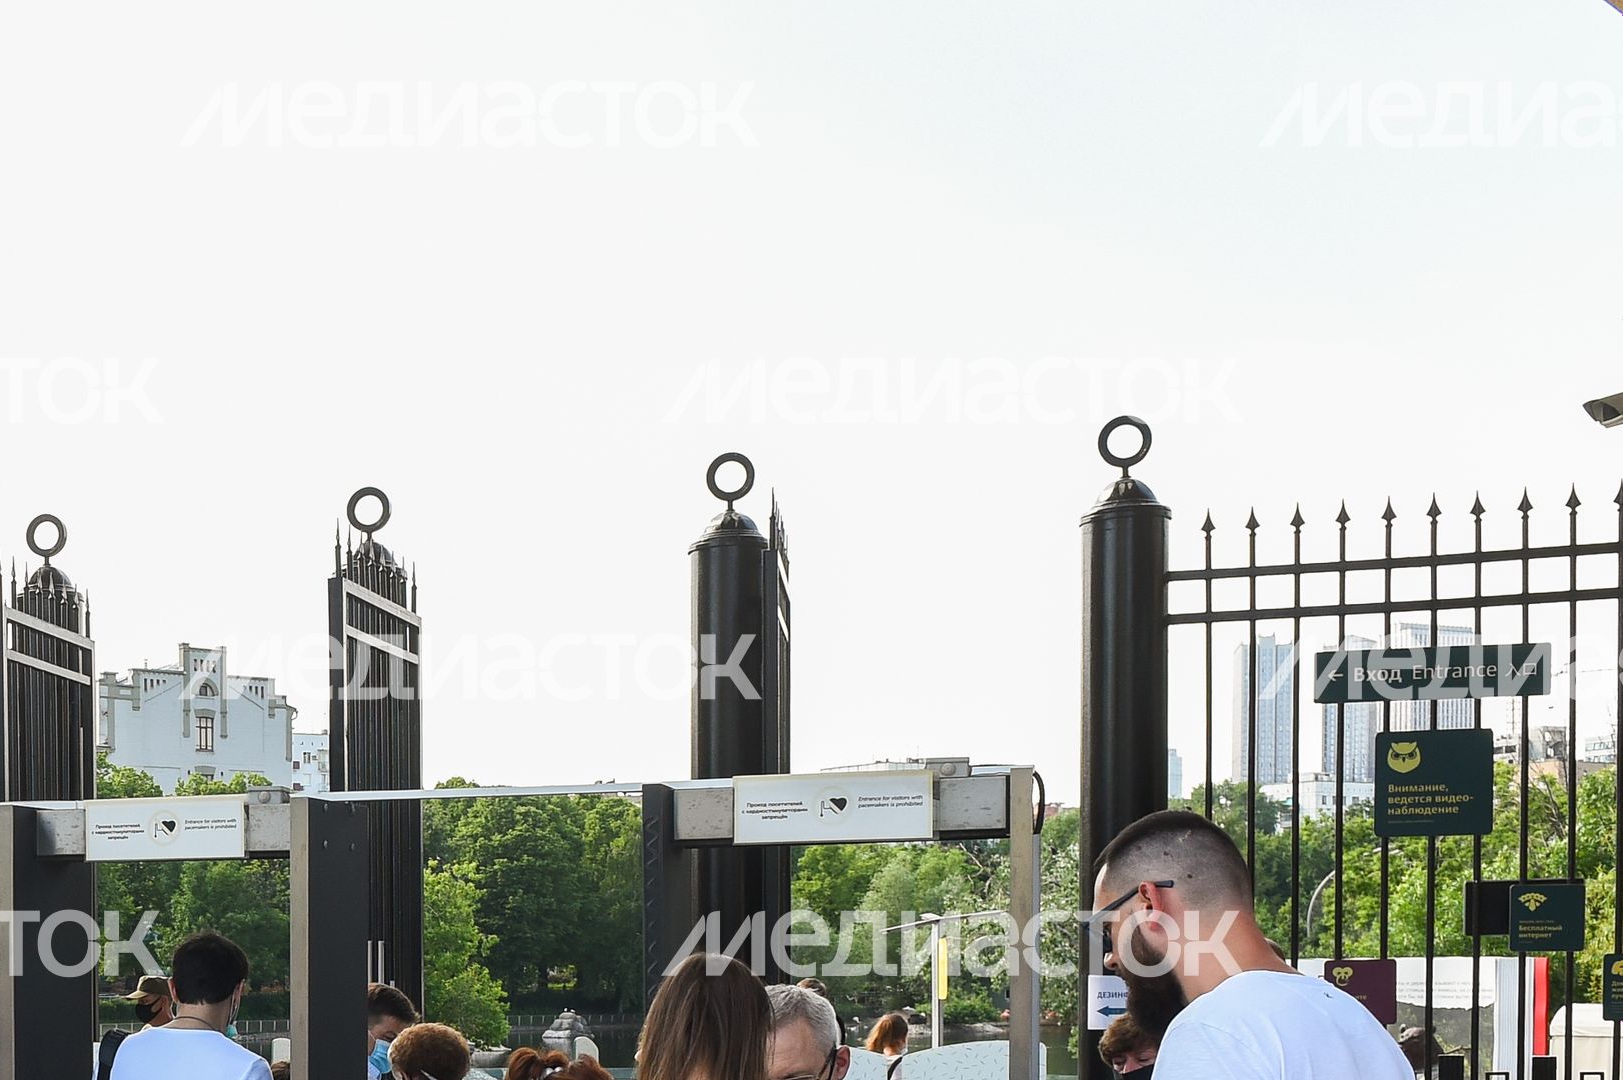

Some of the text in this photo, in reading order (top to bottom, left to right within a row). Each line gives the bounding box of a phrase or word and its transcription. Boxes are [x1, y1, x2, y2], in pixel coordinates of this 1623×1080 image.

[1353, 662, 1538, 684] Вход Entrance 入口
[1387, 783, 1449, 793] Внимание,
[1387, 793, 1474, 805] ведется видео-
[1387, 805, 1459, 816] наблюдение
